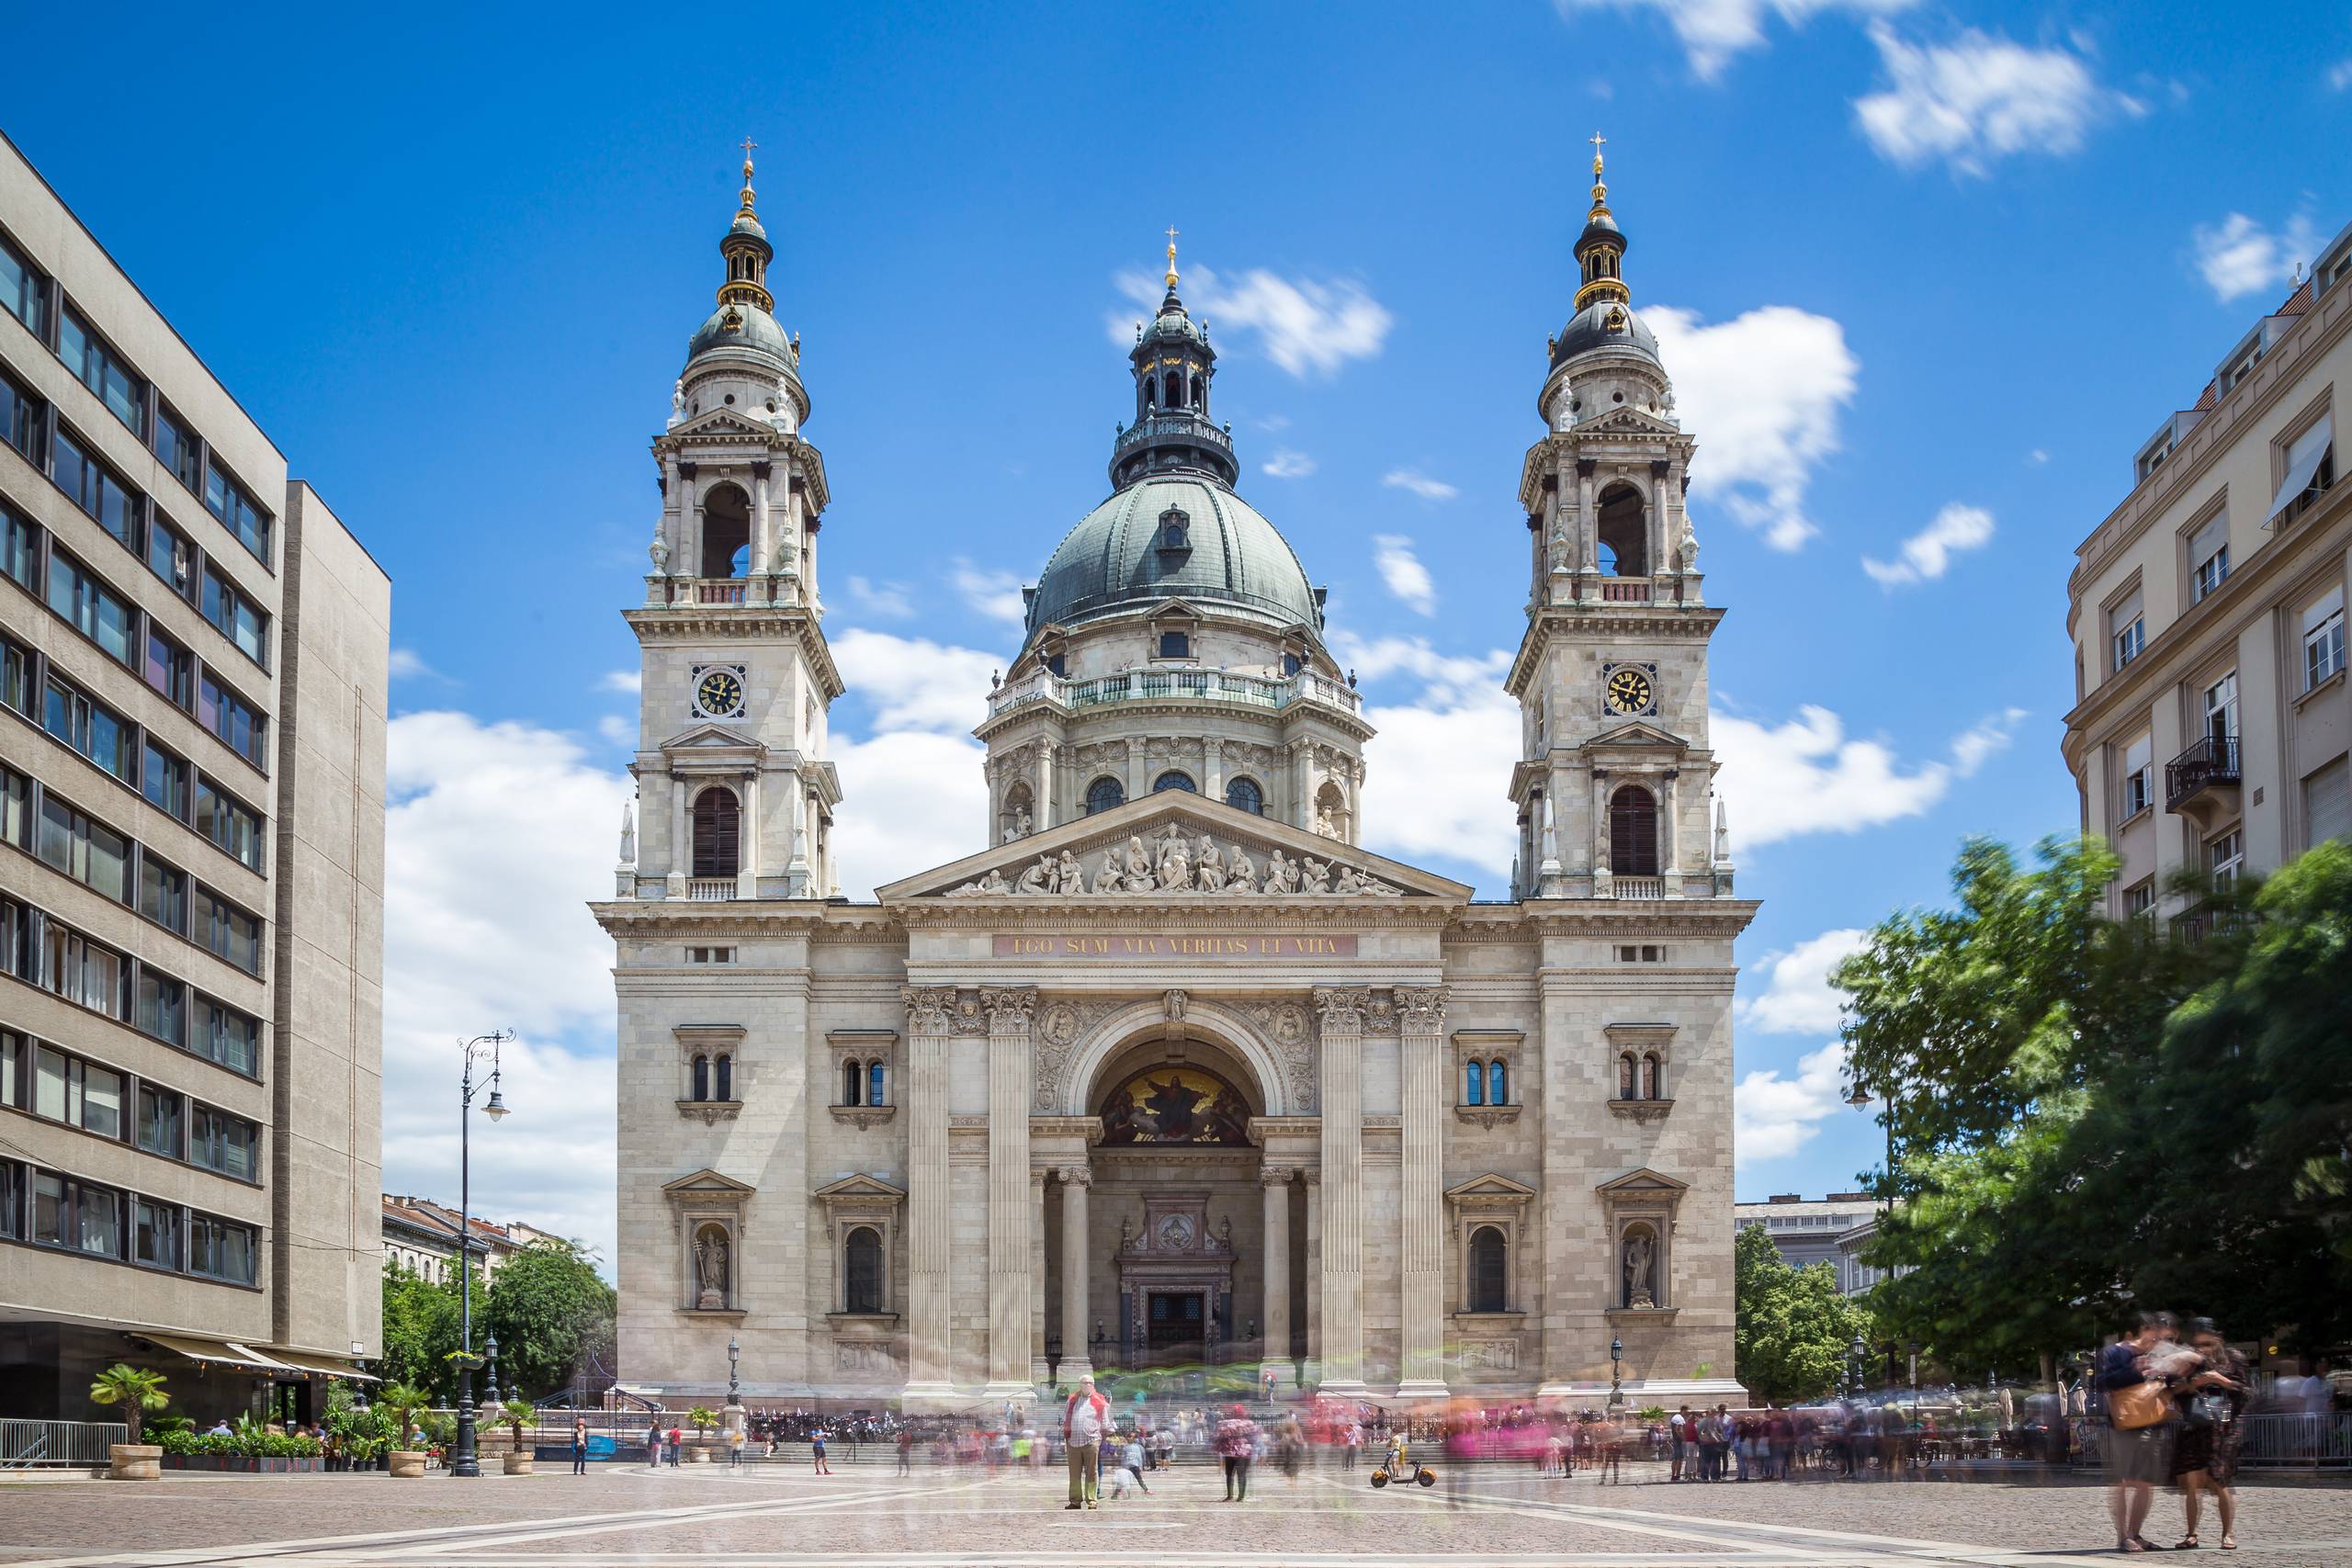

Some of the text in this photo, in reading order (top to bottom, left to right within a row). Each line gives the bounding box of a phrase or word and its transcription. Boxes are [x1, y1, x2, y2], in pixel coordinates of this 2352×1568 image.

[1013, 939, 1338, 954] EGO SUM VIA VERITAS ET VITA
